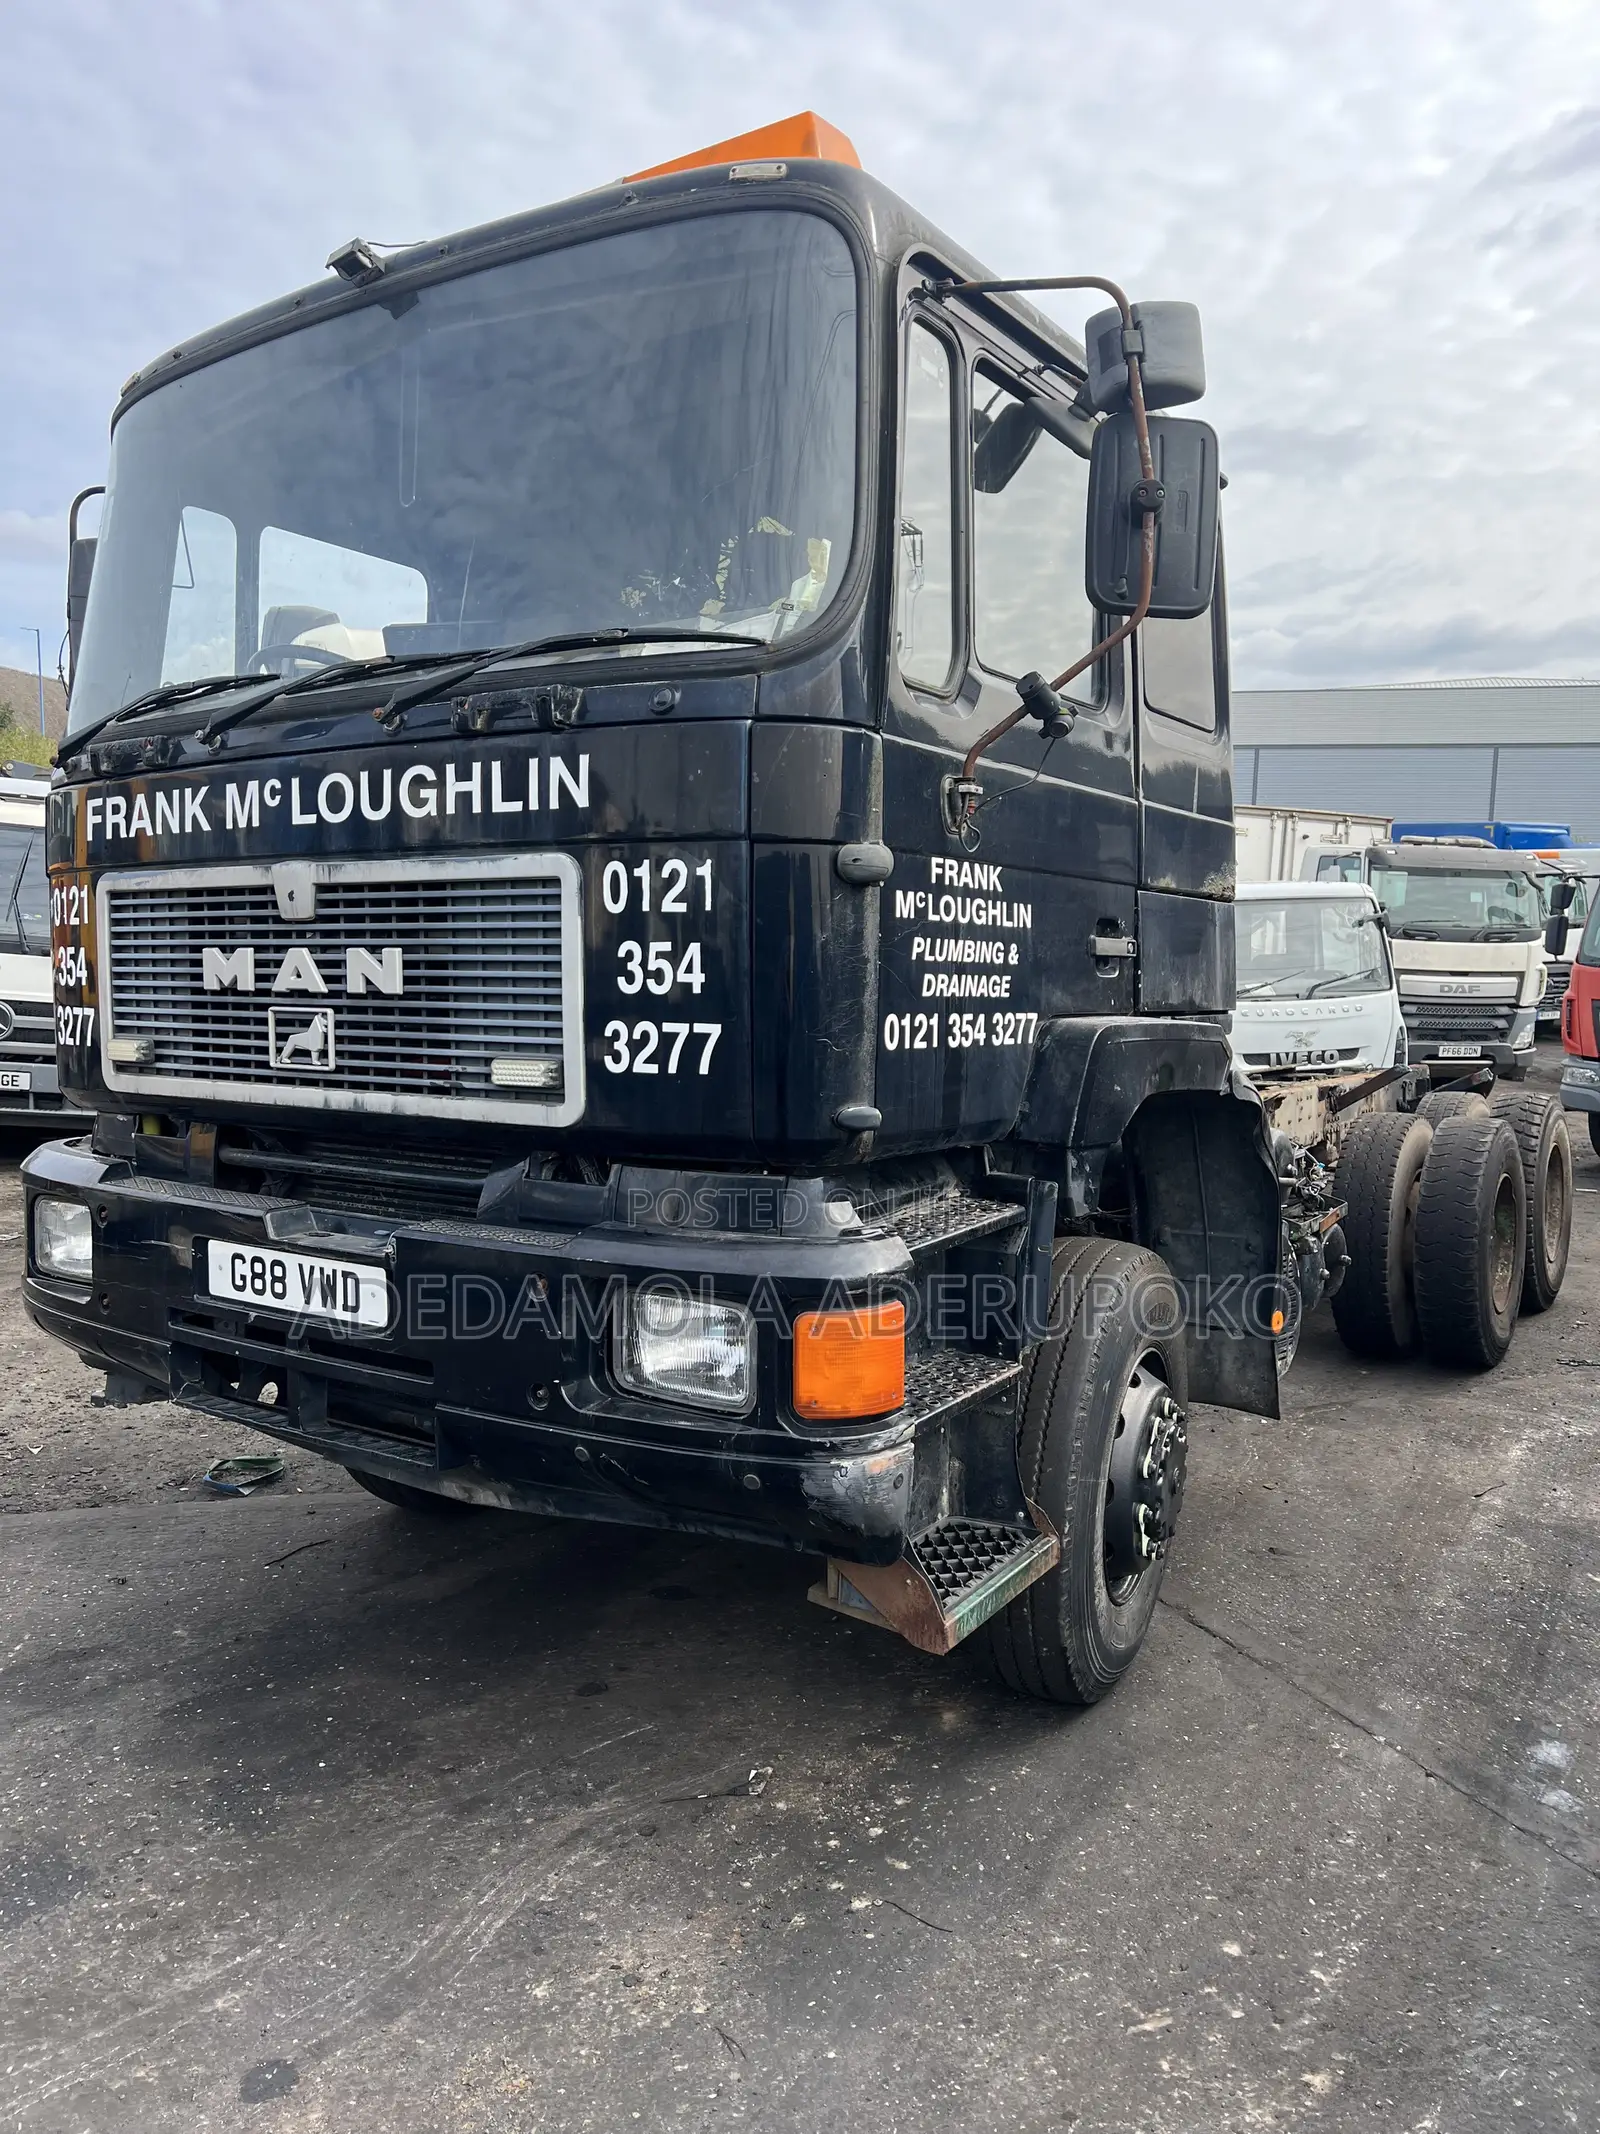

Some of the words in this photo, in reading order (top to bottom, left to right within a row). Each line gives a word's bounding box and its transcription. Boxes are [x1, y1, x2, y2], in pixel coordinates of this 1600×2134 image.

[86, 785, 212, 841] FRANK
[602, 858, 713, 914] 0121
[930, 857, 1003, 892] FRANK
[53, 884, 89, 927] 0121
[58, 946, 88, 987] 354
[202, 947, 404, 995] MAN
[617, 940, 706, 995] 354
[911, 936, 1004, 964] PLUMBING
[1007, 943, 1020, 966] &
[921, 973, 1012, 998] DRAINAGE
[1439, 984, 1481, 994] DAF
[57, 1005, 95, 1047] 3277
[1240, 1003, 1363, 1018] EUROCARGO
[603, 1019, 722, 1075] 3277
[883, 1012, 940, 1051] 0121
[947, 1012, 987, 1048] 354
[991, 1012, 1039, 1047] 3277
[1269, 1048, 1340, 1067] IVECO
[230, 1252, 287, 1301] G88
[297, 1262, 361, 1314] VWD
